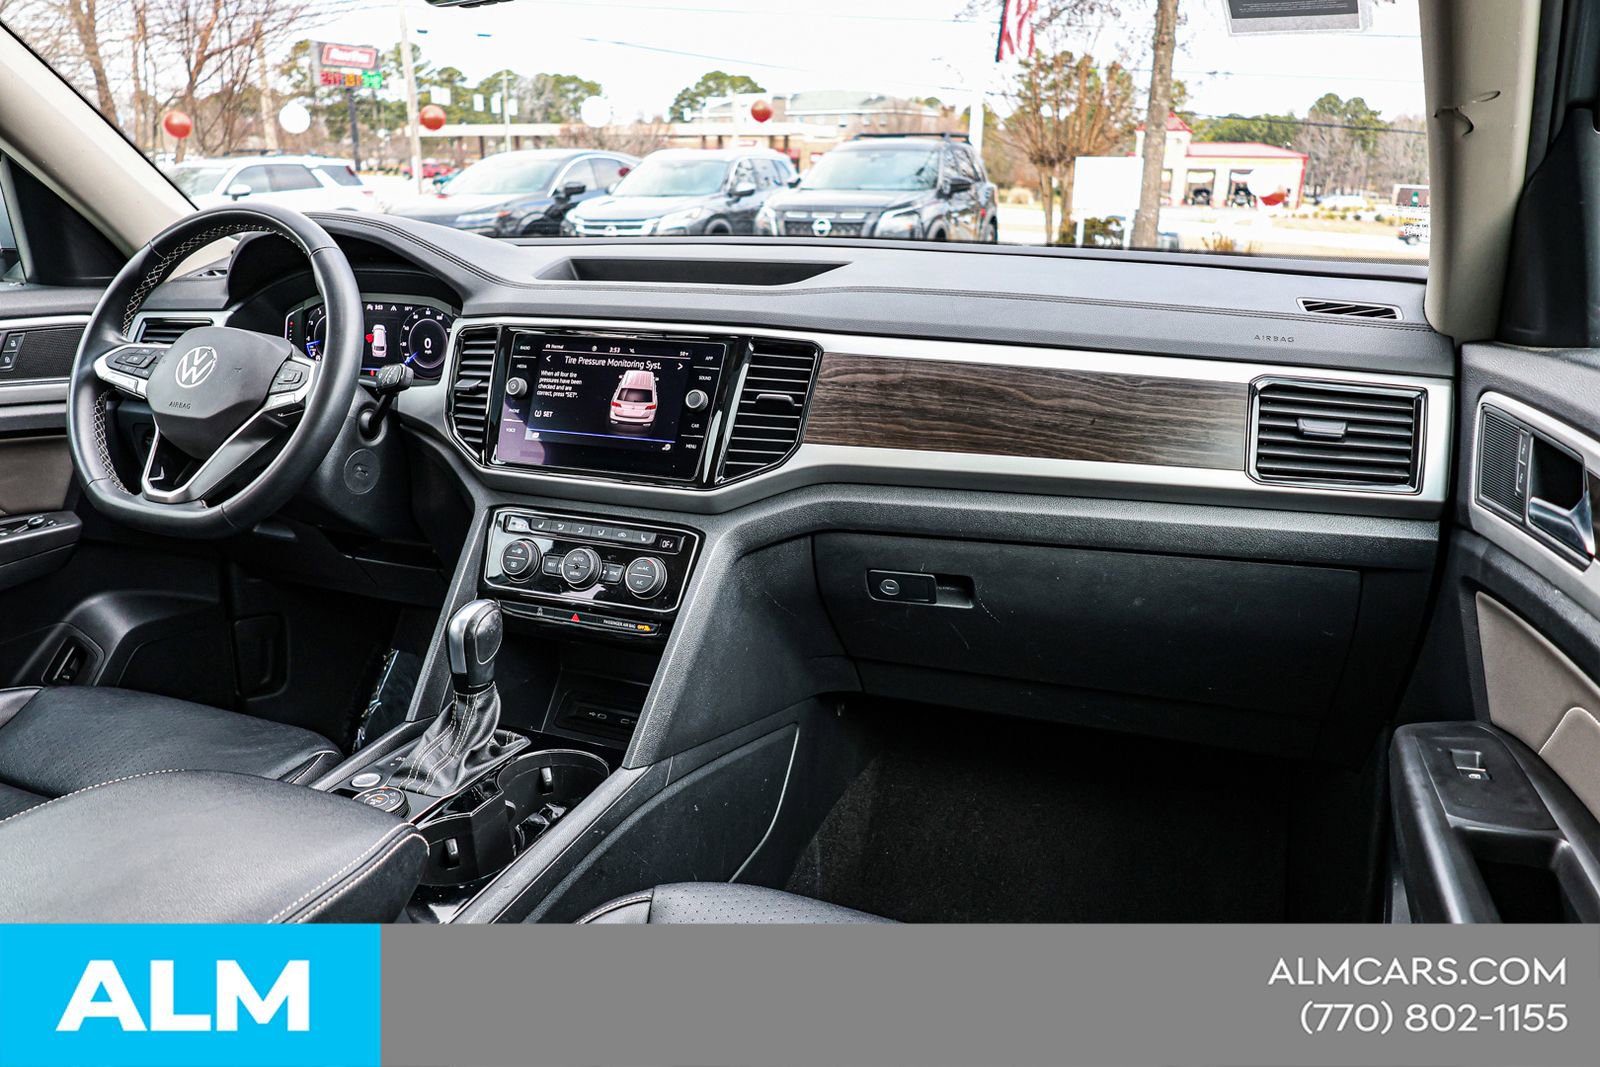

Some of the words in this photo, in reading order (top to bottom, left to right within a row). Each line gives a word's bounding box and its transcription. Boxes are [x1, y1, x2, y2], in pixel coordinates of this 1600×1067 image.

[424, 337, 432, 349] 0
[1254, 334, 1295, 343] AIRBAG
[565, 355, 577, 365] Tire
[577, 356, 606, 367] Pressure
[607, 358, 645, 371] Monitoring
[645, 360, 662, 371] Syst.
[168, 401, 191, 410] AIRBAG
